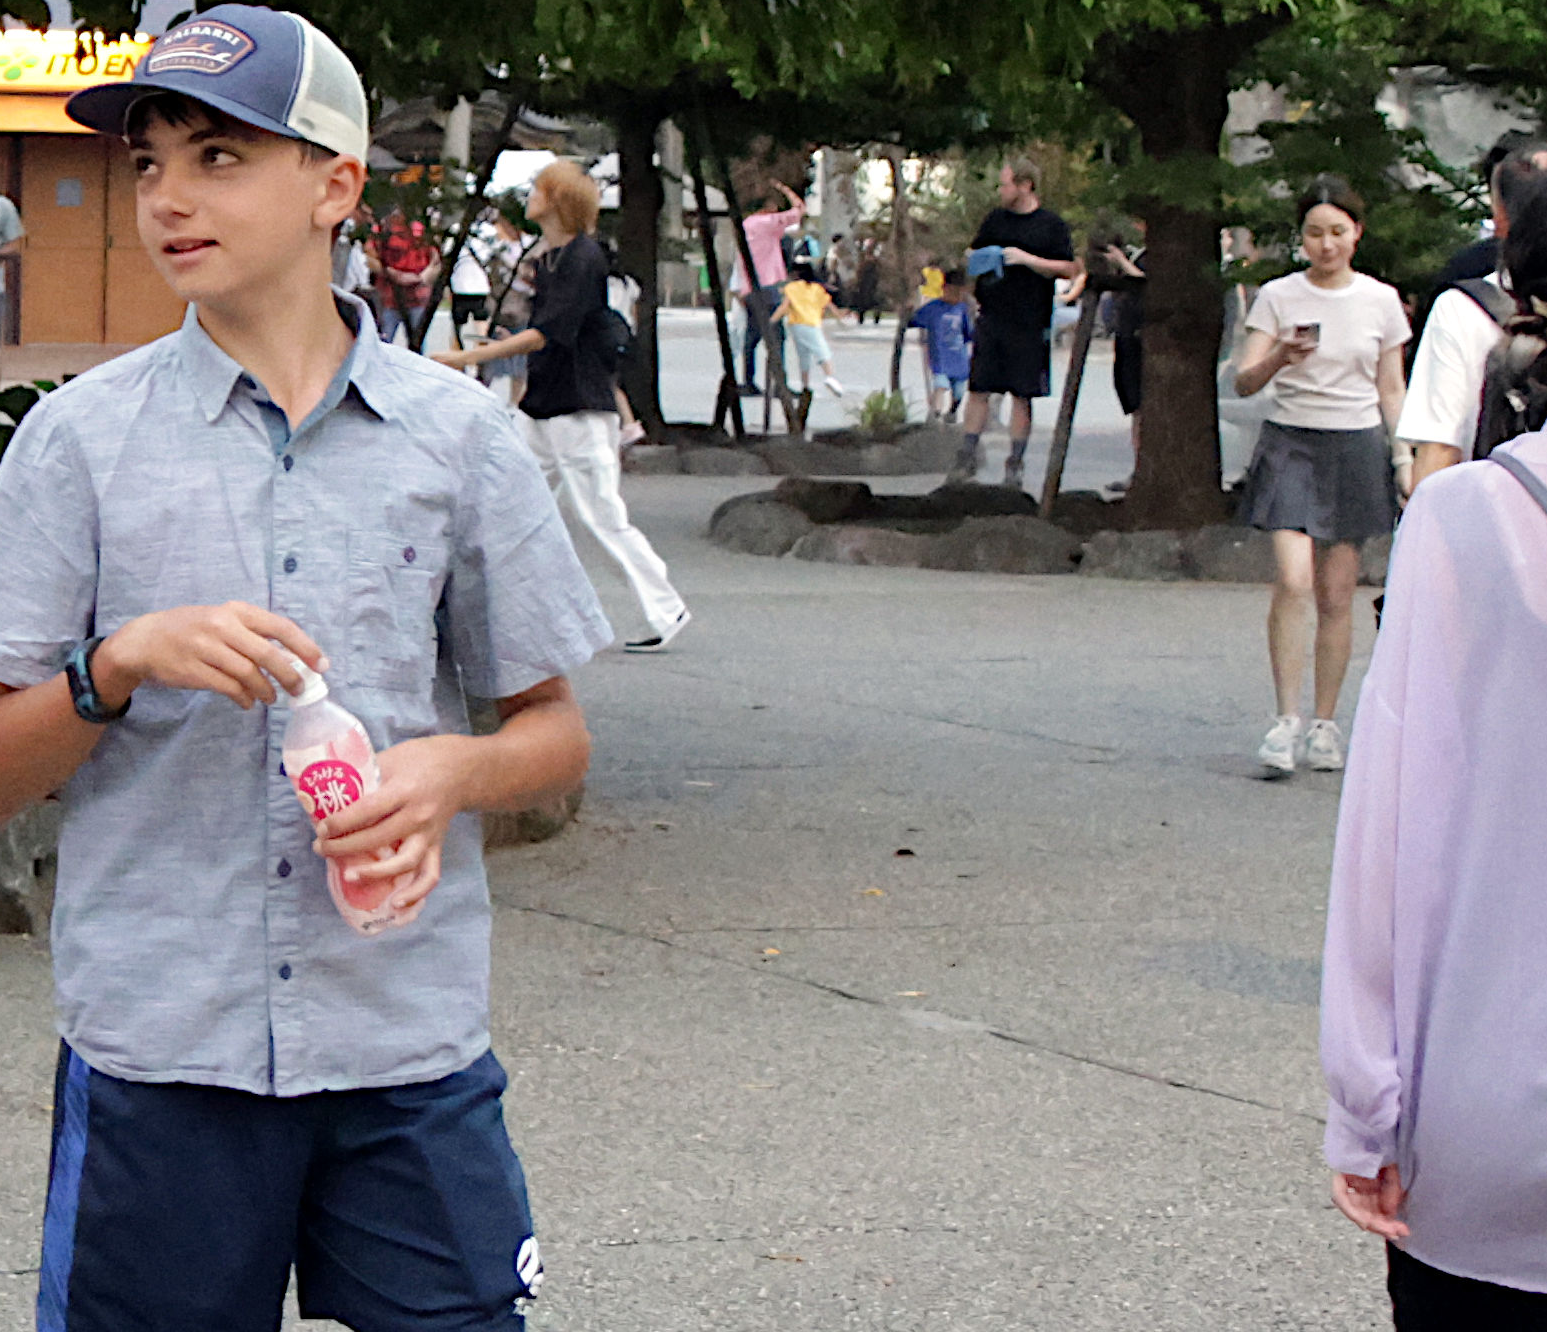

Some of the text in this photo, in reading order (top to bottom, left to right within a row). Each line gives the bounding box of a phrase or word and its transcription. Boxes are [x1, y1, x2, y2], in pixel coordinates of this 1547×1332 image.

[163, 26, 241, 47] KALBARRI
[303, 765, 344, 787] とろける
[313, 779, 351, 815] 桃
